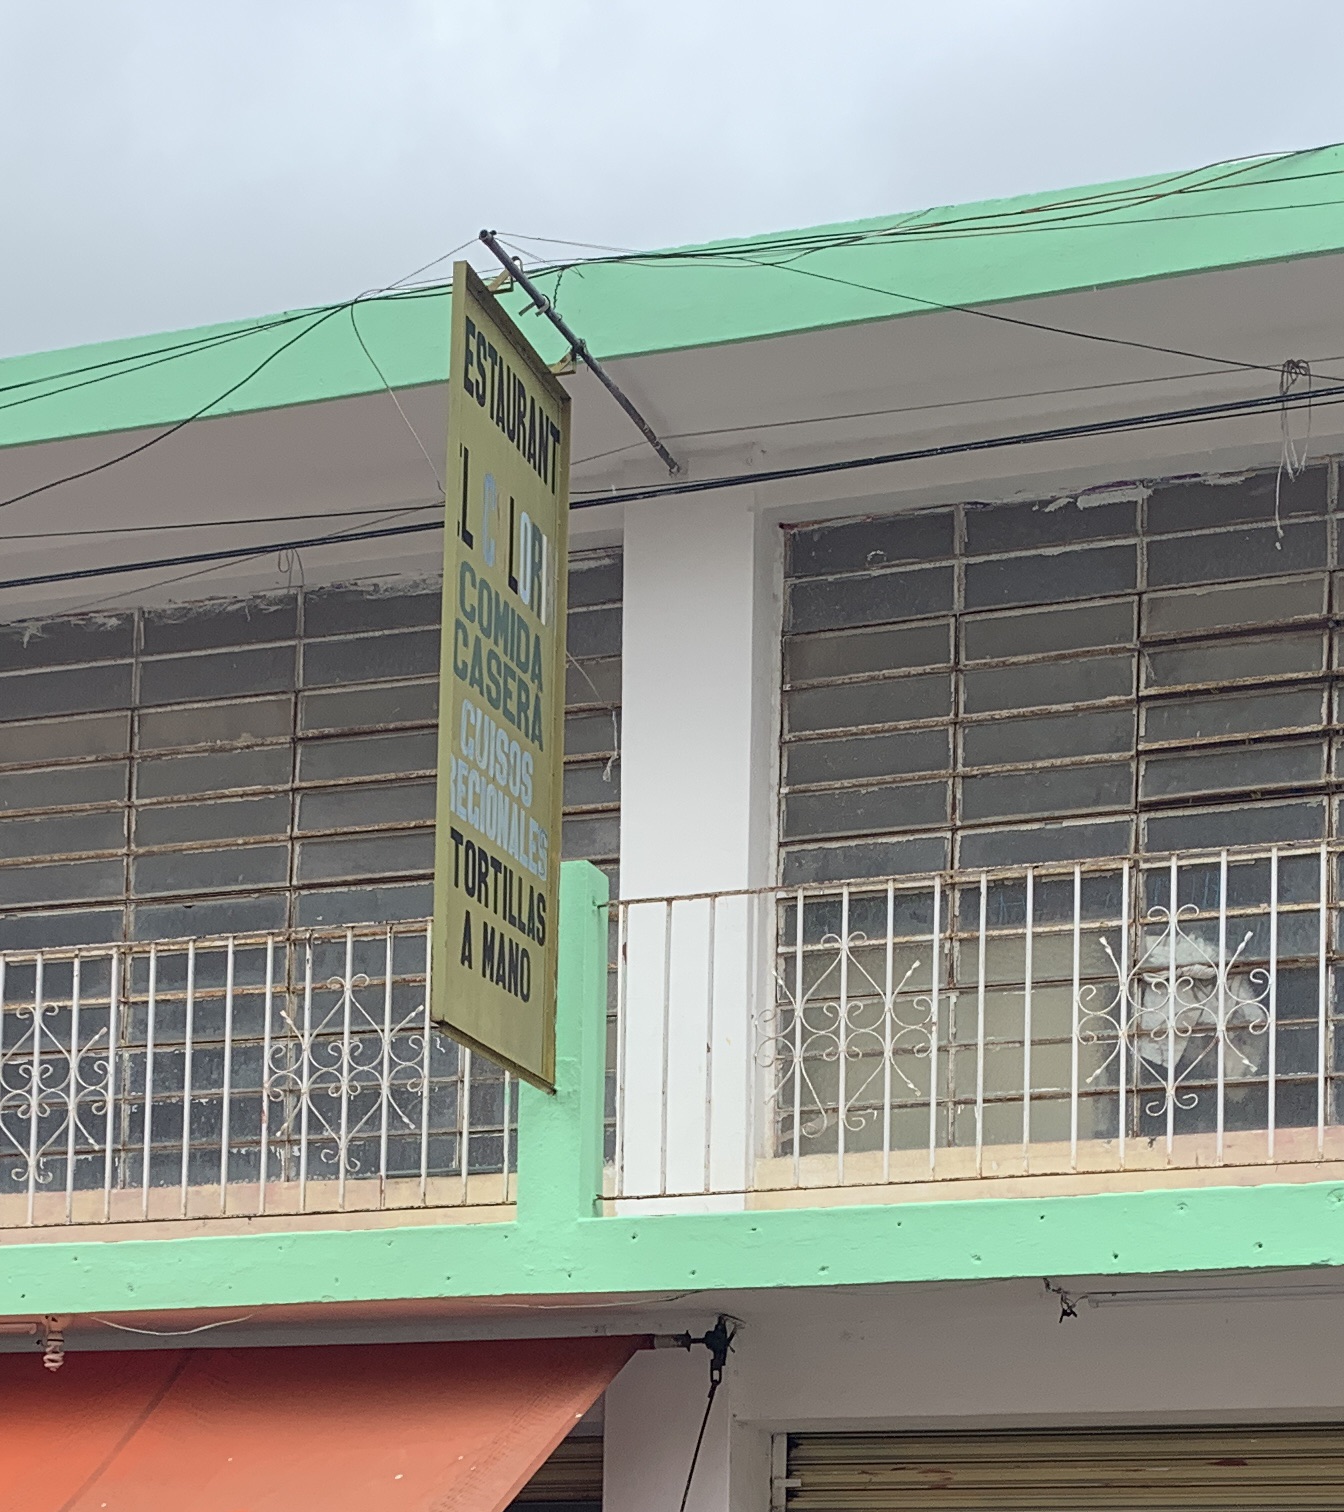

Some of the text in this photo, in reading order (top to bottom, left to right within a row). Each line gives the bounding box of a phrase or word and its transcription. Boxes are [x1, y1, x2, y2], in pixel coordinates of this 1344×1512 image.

[453, 617, 544, 752] CASERA
[459, 560, 543, 693] COMIDA
[450, 826, 547, 947] TORTILLAS
[460, 909, 531, 1003] A MANO
